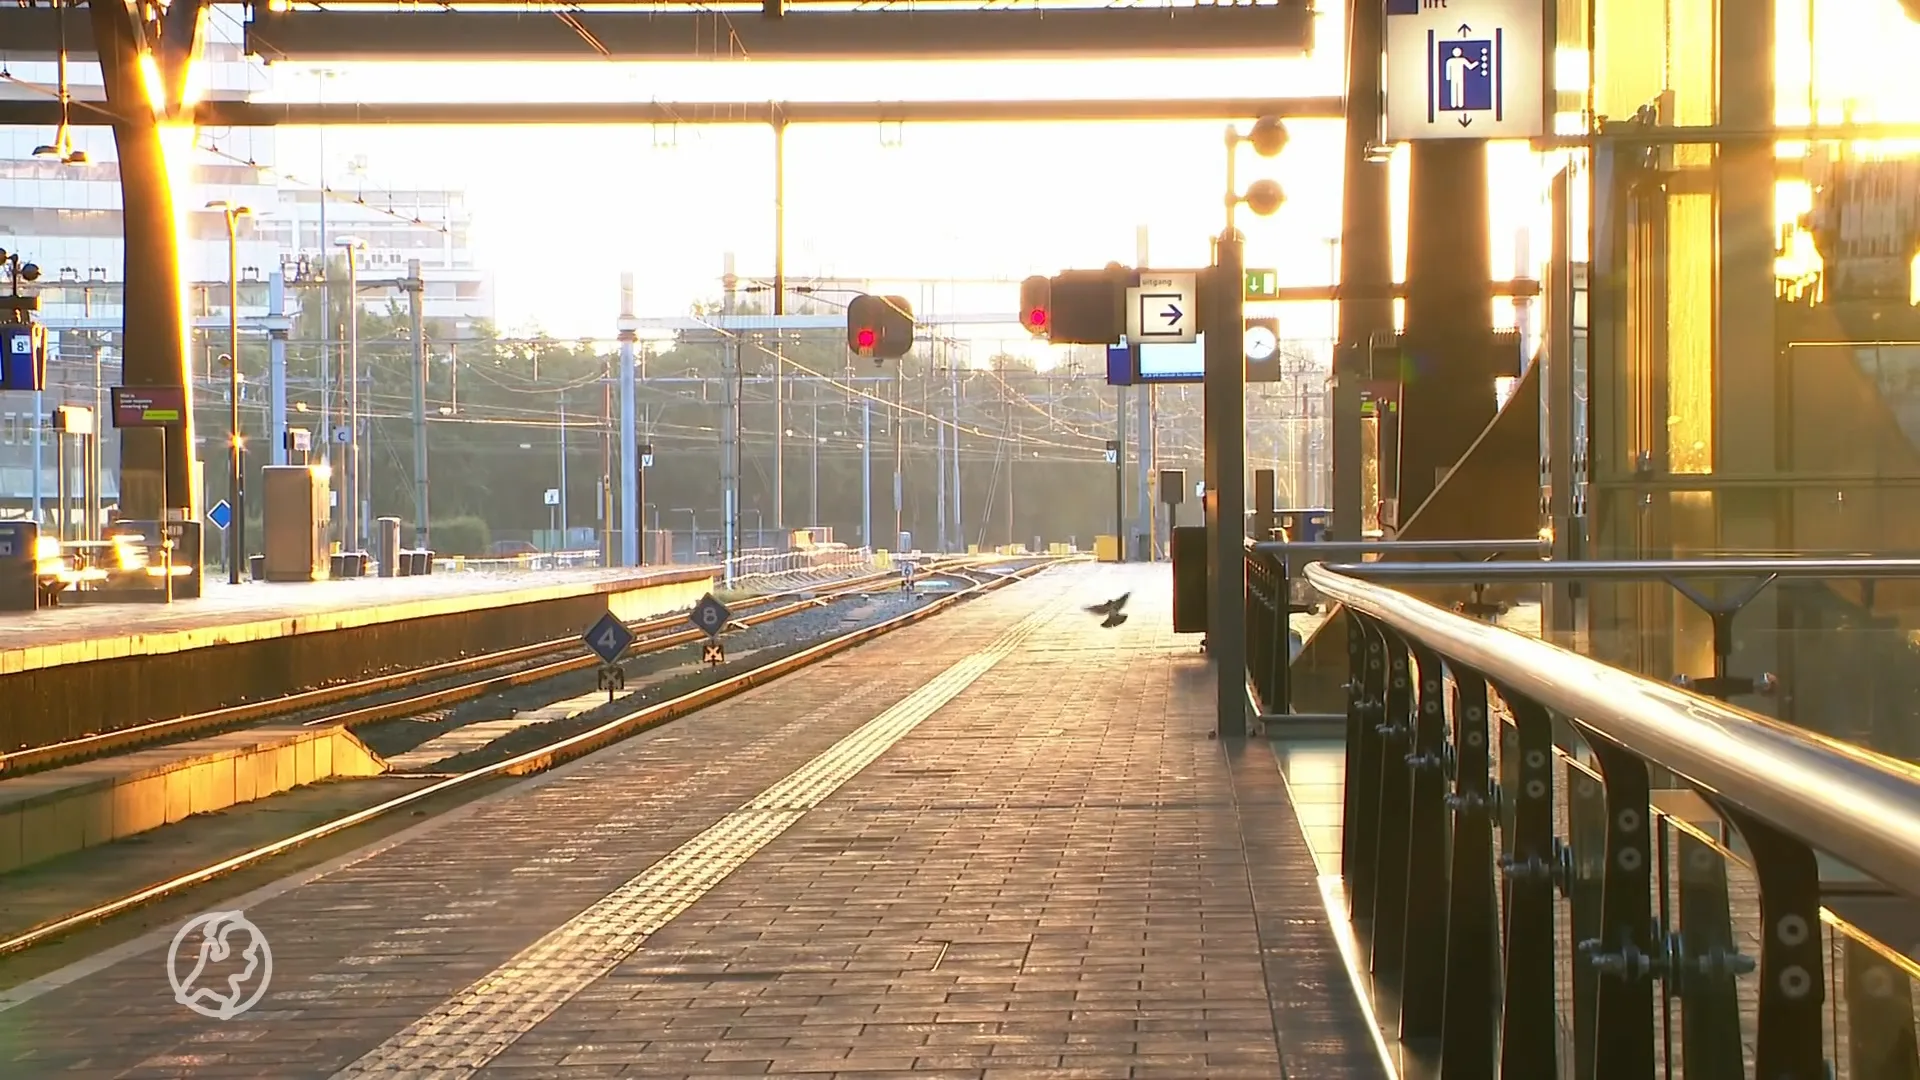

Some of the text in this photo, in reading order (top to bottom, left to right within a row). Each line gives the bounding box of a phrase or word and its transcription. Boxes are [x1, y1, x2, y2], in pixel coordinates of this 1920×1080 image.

[338, 432, 346, 441] C
[703, 607, 717, 624] 8
[597, 625, 616, 649] 4
